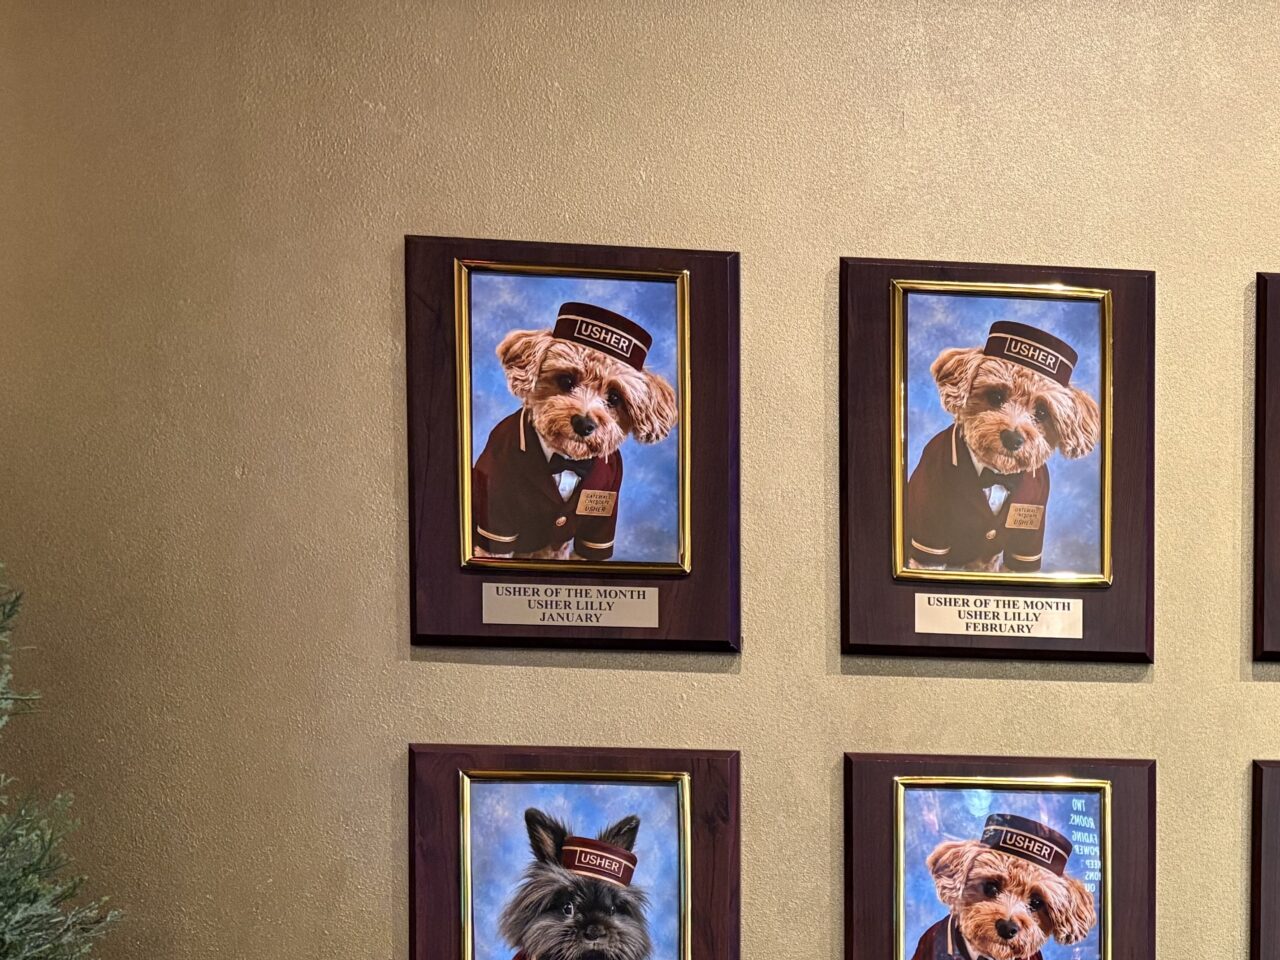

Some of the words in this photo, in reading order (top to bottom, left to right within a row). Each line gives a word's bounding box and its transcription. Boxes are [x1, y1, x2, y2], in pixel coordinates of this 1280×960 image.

[581, 323, 629, 350] USHER
[1011, 341, 1060, 368] USHER
[495, 586, 541, 597] USHER
[543, 587, 562, 597] OF
[564, 588, 592, 598] THE
[595, 588, 645, 599] MONTH
[527, 599, 572, 610] USHER
[575, 600, 614, 611] LILLY
[927, 596, 970, 607] USHER
[973, 598, 991, 608] OF
[993, 599, 1019, 609] THE
[1023, 600, 1070, 610] MONTH
[539, 612, 602, 622] JANUARY
[957, 609, 1000, 620] USHER
[1003, 611, 1040, 622] LILLY
[965, 622, 1033, 633] FEBRUARY
[1006, 833, 1055, 860] USHER
[581, 852, 620, 872] USHER
